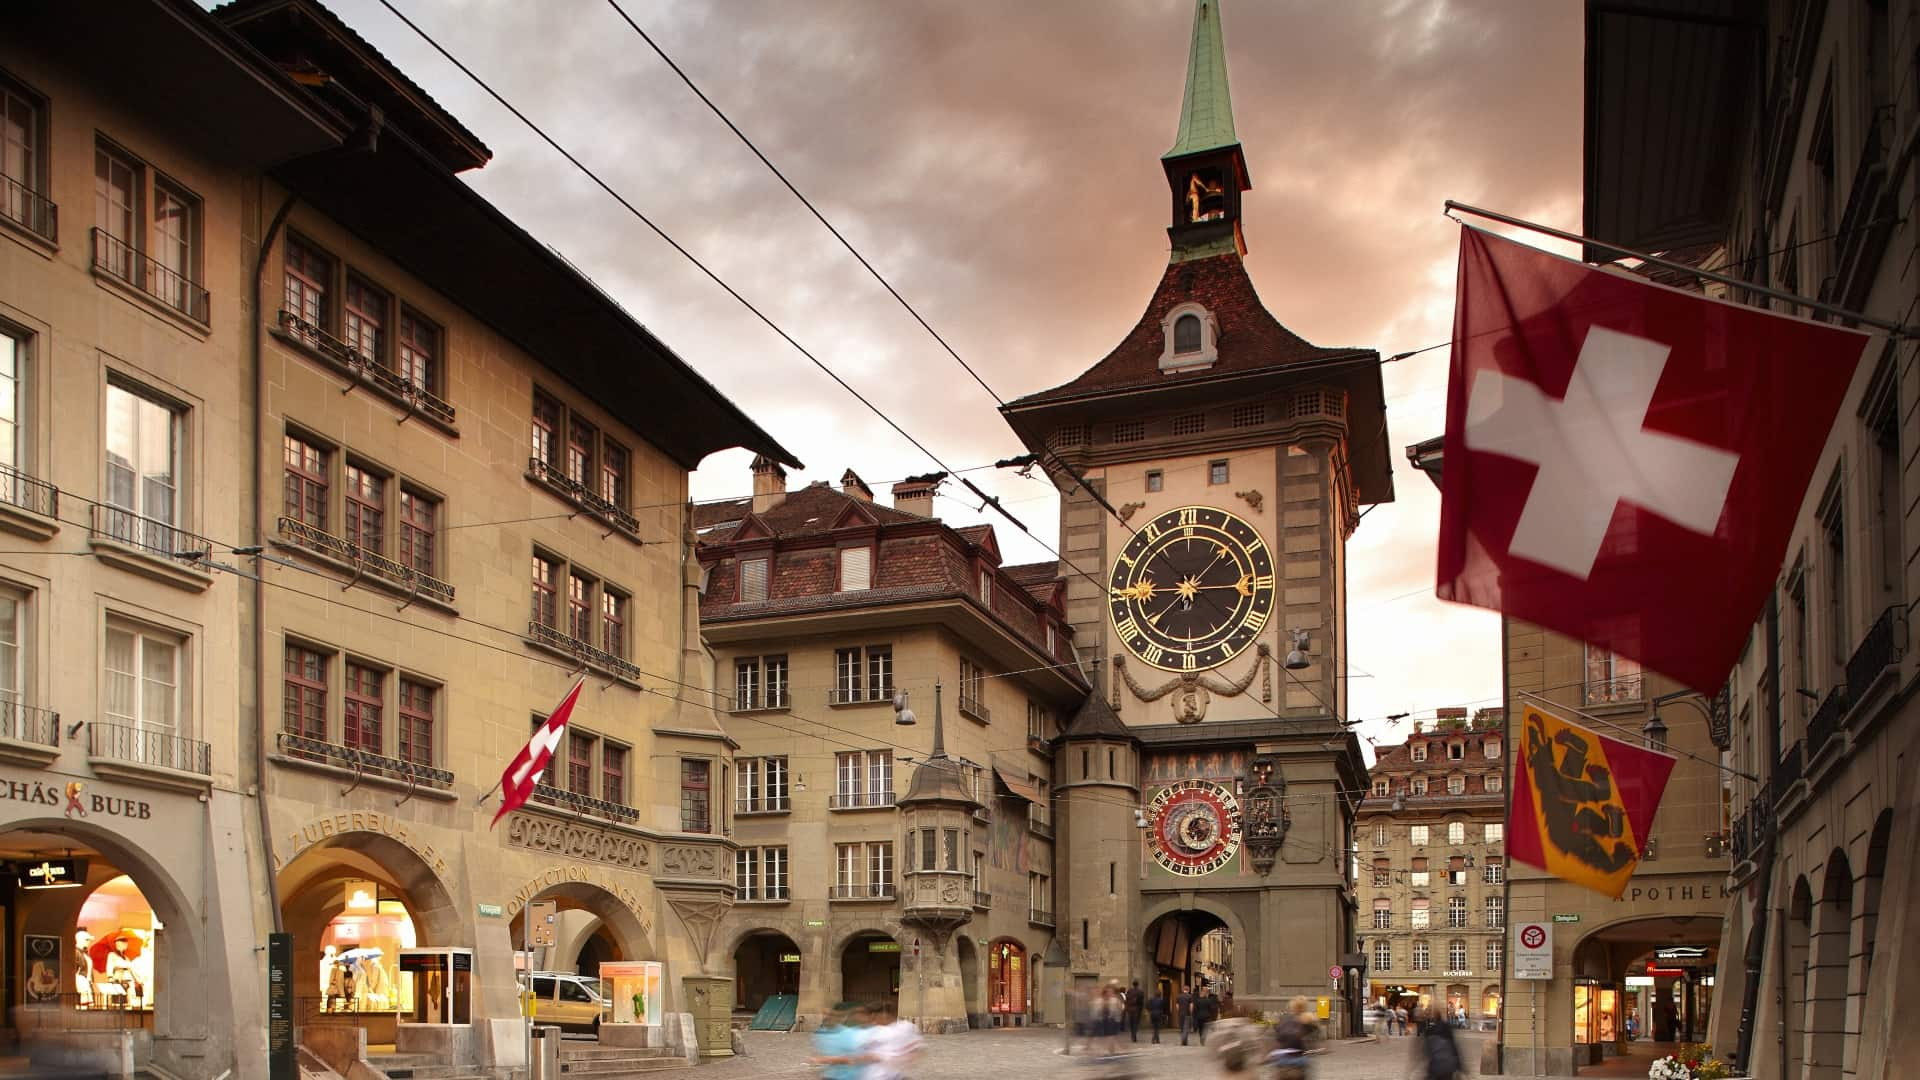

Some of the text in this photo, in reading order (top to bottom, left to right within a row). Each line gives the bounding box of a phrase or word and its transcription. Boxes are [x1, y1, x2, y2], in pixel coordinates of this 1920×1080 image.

[1178, 508, 1197, 526] XII
[1144, 523, 1161, 543] XI
[1246, 538, 1262, 554] II
[1120, 552, 1135, 568] X
[1256, 574, 1273, 590] III
[91, 794, 151, 820] BUEB
[1612, 885, 1731, 902] POTHEK
